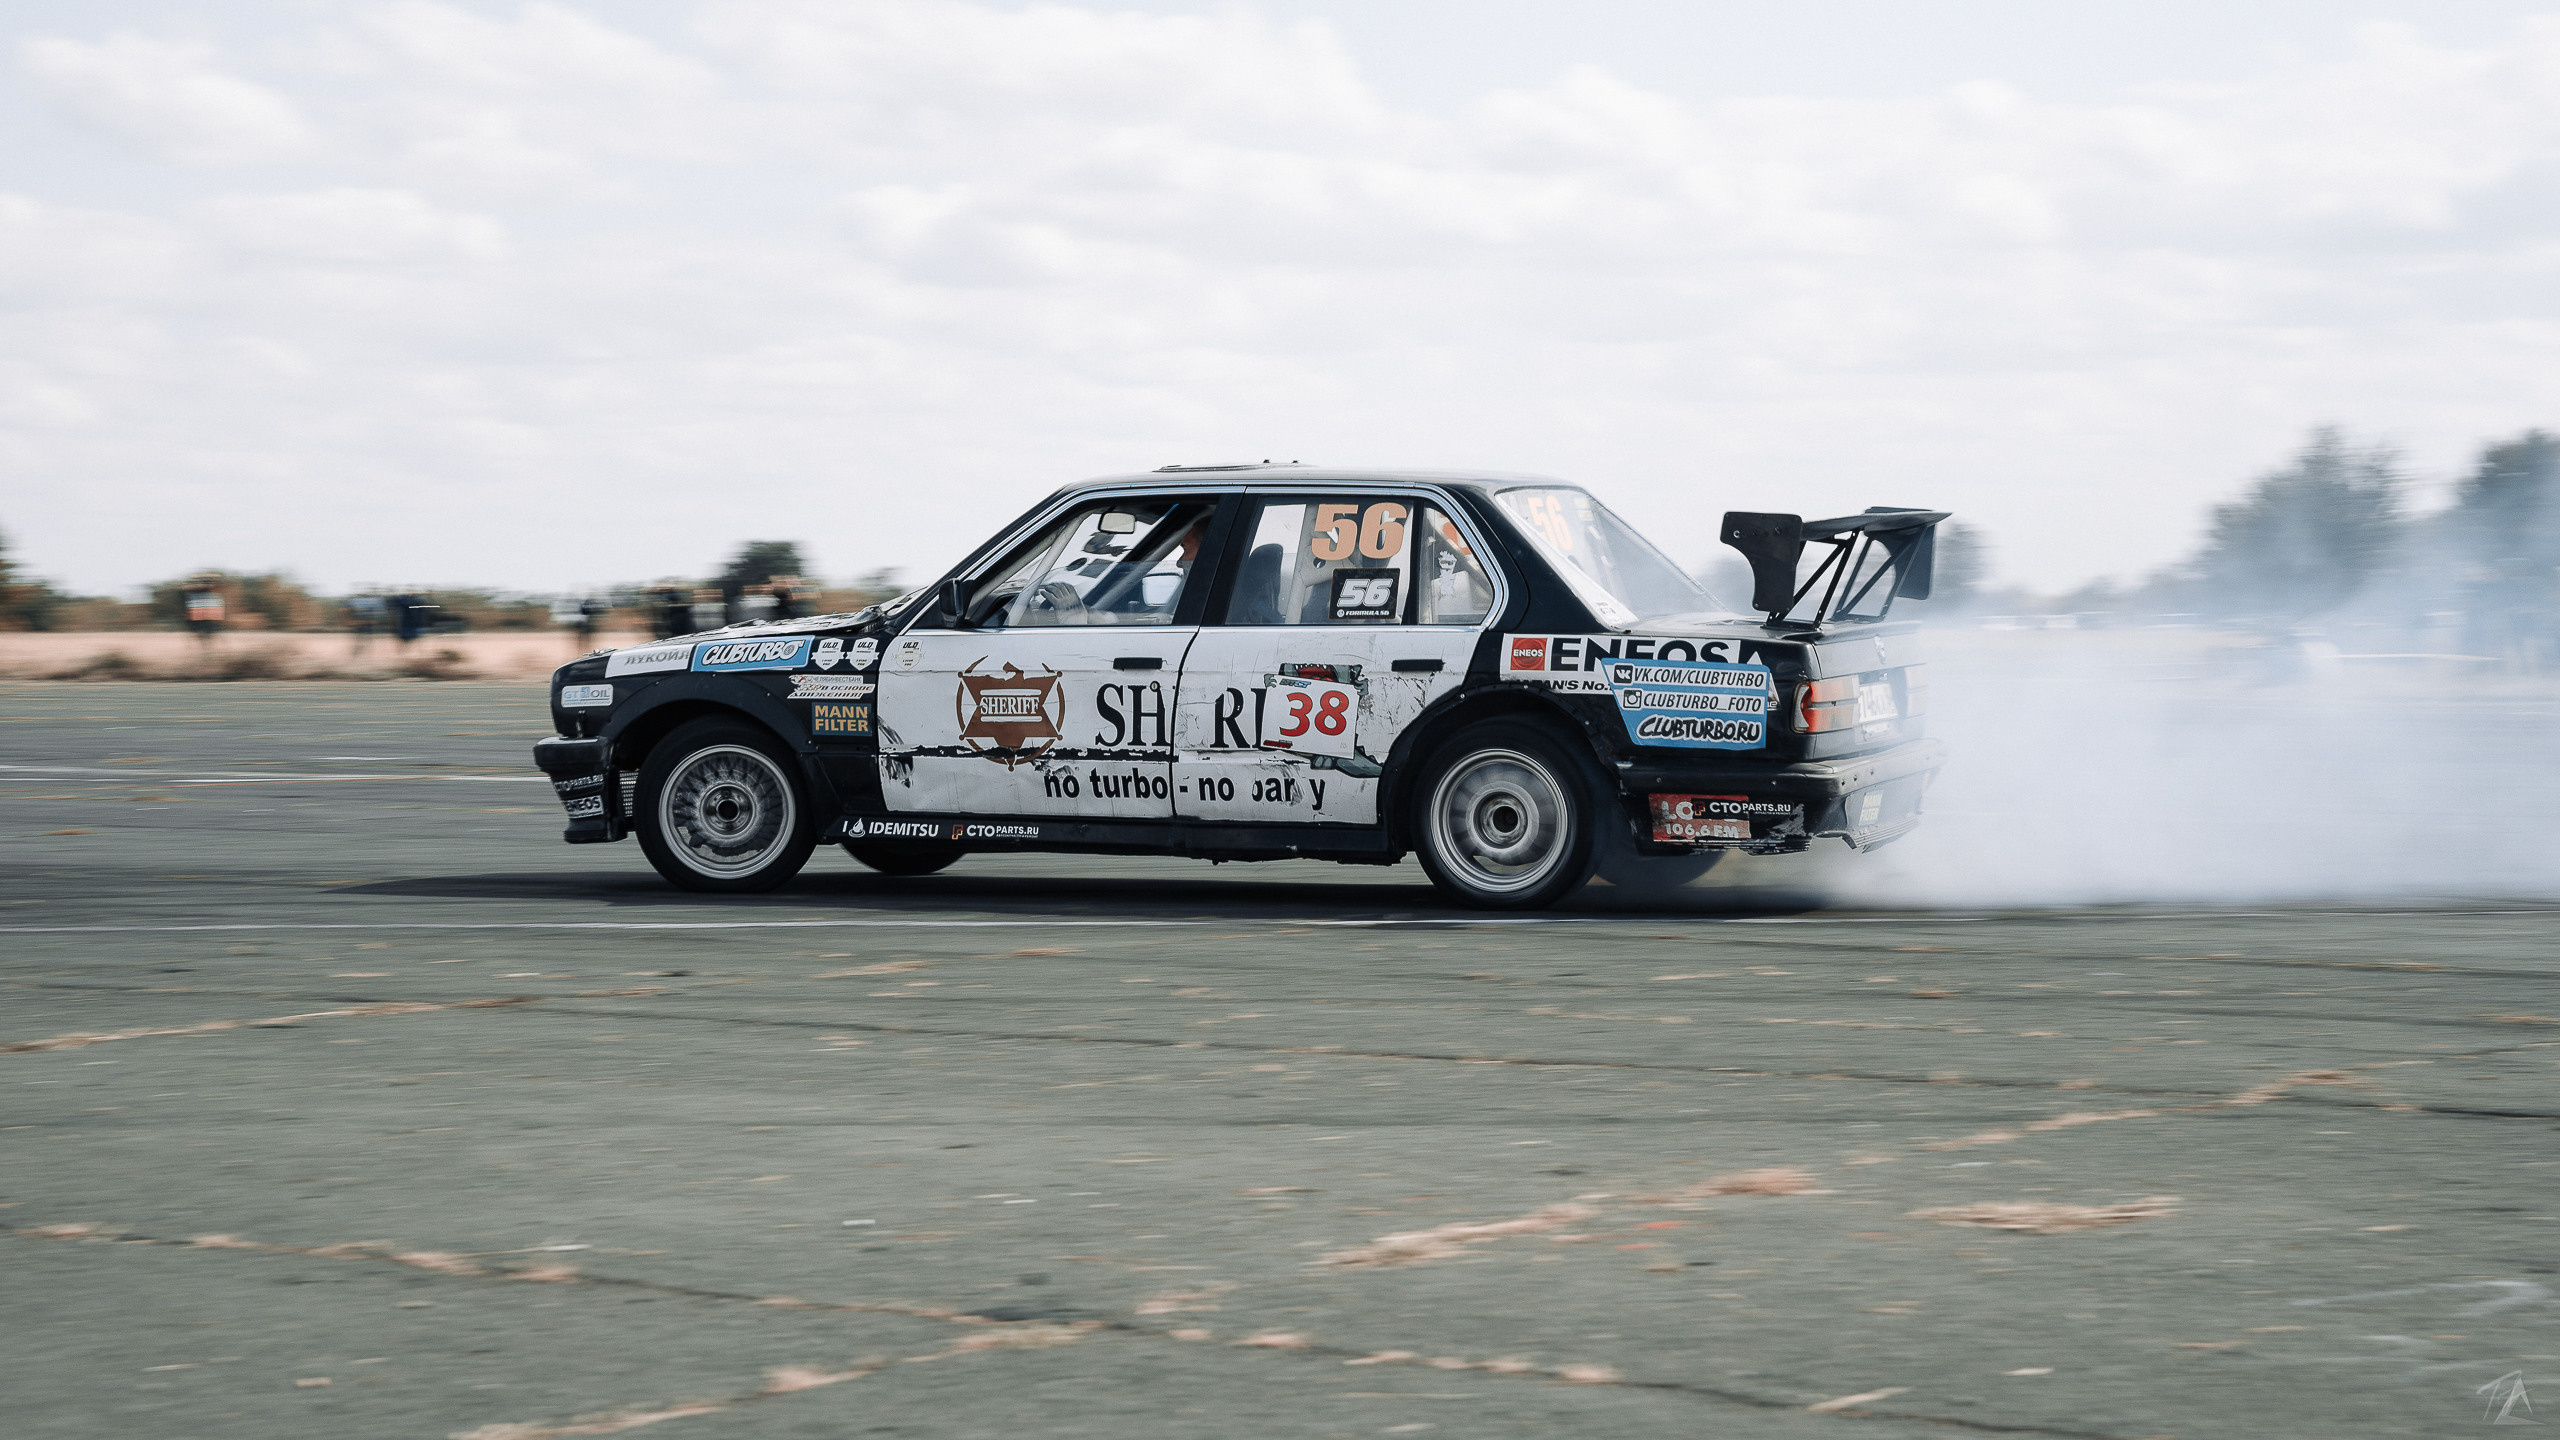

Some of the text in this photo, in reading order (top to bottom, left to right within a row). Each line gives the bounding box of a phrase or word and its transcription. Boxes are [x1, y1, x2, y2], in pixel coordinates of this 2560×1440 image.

[1527, 495, 1573, 551] 56
[1311, 502, 1407, 561] 56
[1336, 578, 1394, 607] 56
[702, 640, 806, 666] CLUBTURBO
[822, 641, 839, 649] ULD
[857, 641, 874, 649] ULD
[903, 641, 920, 649] ULD
[1513, 649, 1544, 658] ENEOS
[1634, 668, 1764, 688] VK.COM/CLUBTURBO
[563, 689, 610, 699] GT OIL
[980, 696, 1040, 715] SHERIFF
[1643, 693, 1762, 712] CLUBTURBO_FOTO
[815, 705, 868, 719] MANN
[1279, 690, 1349, 737] 38
[815, 719, 869, 732] FILTER
[1638, 715, 1761, 742] CLUBTURBO.RU
[1044, 774, 1080, 799] no
[1090, 767, 1168, 800] turbo
[1199, 776, 1235, 801] no
[1709, 802, 1791, 814] CTOPARTS.RU
[868, 821, 939, 837] IDEMITSU
[966, 824, 1039, 838] CTOPARTS.RU
[1664, 823, 1739, 838] 106.6 FM
